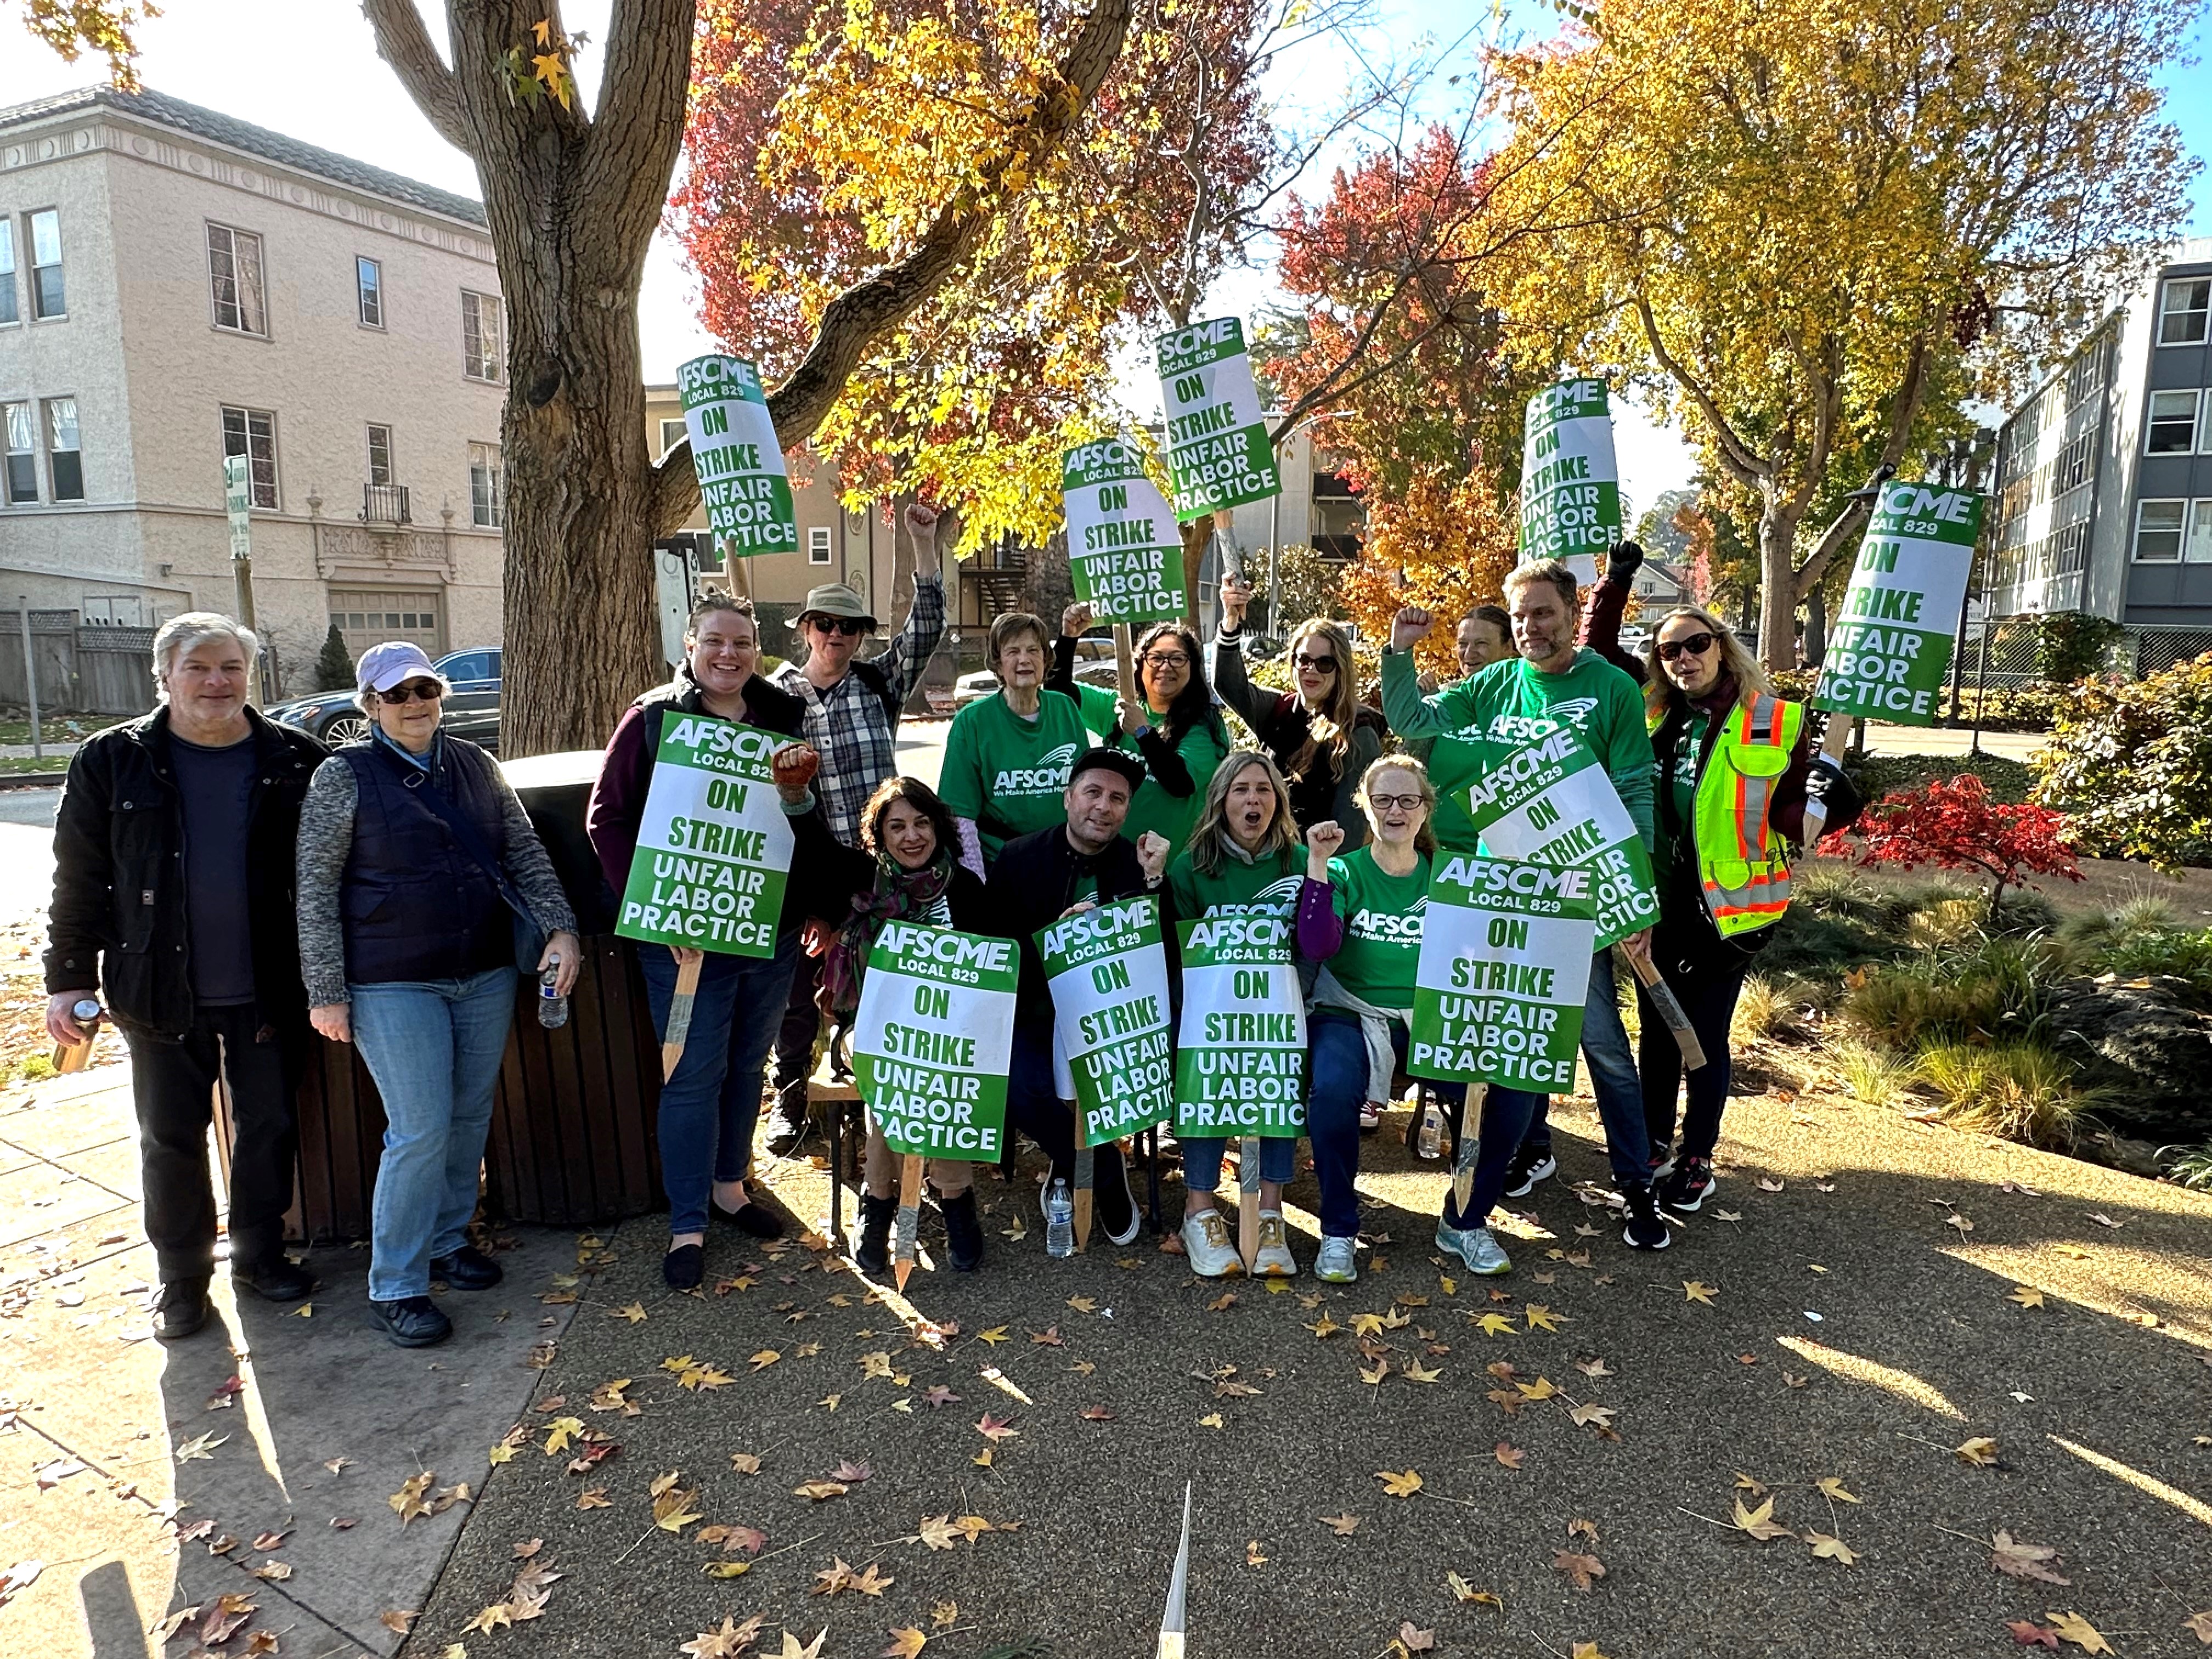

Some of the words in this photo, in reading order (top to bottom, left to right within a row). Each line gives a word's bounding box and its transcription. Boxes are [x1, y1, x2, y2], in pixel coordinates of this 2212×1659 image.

[1156, 318, 1234, 361] SCME
[1159, 357, 1193, 376] LOCAL
[1195, 348, 1217, 363] 829
[688, 386, 717, 405] LOCAL
[721, 385, 744, 396] 829
[1175, 373, 1205, 404] ON
[1527, 381, 1599, 420] SCME
[701, 406, 729, 437] ON
[1169, 402, 1237, 443] STRIKE
[1555, 405, 1579, 418] 829
[1065, 441, 1138, 475] AFSC
[1170, 432, 1250, 471] UNFAIR
[1536, 427, 1560, 459] ON
[695, 444, 761, 479] STRIKE
[1083, 467, 1120, 482] LOCAL
[1178, 454, 1250, 490] LABOR
[1524, 455, 1590, 501] STRIKE
[711, 501, 773, 530] ABOR
[1098, 485, 1128, 512] ON
[1522, 486, 1600, 528] UNFAIR
[1874, 484, 1973, 524] SCME
[714, 523, 795, 552] ACTICE
[1085, 519, 1155, 550] STRIKE
[1525, 506, 1598, 546] LABOR
[1869, 518, 1898, 532] CAL
[1904, 520, 1938, 535] 829
[1085, 550, 1165, 577] UNFAIR
[1861, 541, 1900, 573] ON
[1090, 572, 1163, 598] LABOR
[1088, 590, 1184, 619] RACTICE
[1844, 587, 1925, 623] TRIKE
[1829, 625, 1923, 659] NFAIR
[1825, 650, 1910, 684] ABOR
[1815, 676, 1932, 715] ACTICE
[665, 719, 793, 761] AFSCM
[1487, 714, 1559, 741] AFSC
[692, 752, 746, 774] LOCAL
[1468, 727, 1578, 815] AFSCME
[707, 779, 748, 814] ON
[1499, 782, 1537, 811] LOCAL
[1536, 765, 1564, 786] 829
[1526, 796, 1561, 832] ON
[668, 816, 767, 862] STRIKE
[653, 854, 766, 895] UNFAIR
[1436, 857, 1592, 899] AFSCME
[651, 881, 755, 919] LABOR
[1468, 891, 1525, 909] LOCAL
[1530, 899, 1561, 913] 829
[622, 901, 773, 947] PRACTICE
[1043, 900, 1152, 961] AFSCME
[1186, 918, 1294, 949] AFSCM
[1350, 908, 1425, 936] AFSC
[1361, 931, 1386, 941] Make
[1386, 934, 1423, 945] Americ
[1487, 917, 1529, 951] ON
[874, 924, 1012, 971] AFSCME
[1065, 940, 1115, 965] LOCAL
[1116, 932, 1141, 948] 829
[1215, 948, 1264, 961] LOCAL
[1267, 949, 1291, 961] 829
[898, 957, 947, 978] LOCAL
[951, 967, 979, 983] 829
[1091, 959, 1131, 995] ON
[1233, 970, 1269, 1000] ON
[1451, 957, 1555, 998] STRIKE
[913, 985, 950, 1020] ON
[1079, 994, 1161, 1045] STRIKE
[1440, 995, 1559, 1032] UNFAIR
[1205, 1012, 1297, 1042] STRIKE
[1442, 1022, 1549, 1057] LABOR
[883, 1023, 975, 1067] STRIKE
[1085, 1032, 1170, 1079] UNFAIR
[873, 1059, 981, 1099] UNFAIR
[1095, 1057, 1171, 1103] LABOR
[1197, 1052, 1302, 1075] UNFAIR
[1413, 1042, 1572, 1084] PRACTICE
[873, 1086, 973, 1124] LABOR
[1203, 1077, 1300, 1101] LABOR
[1086, 1080, 1175, 1135] PRACTIC
[1179, 1102, 1305, 1126] PRACTIC
[872, 1111, 997, 1150] ACTICE
